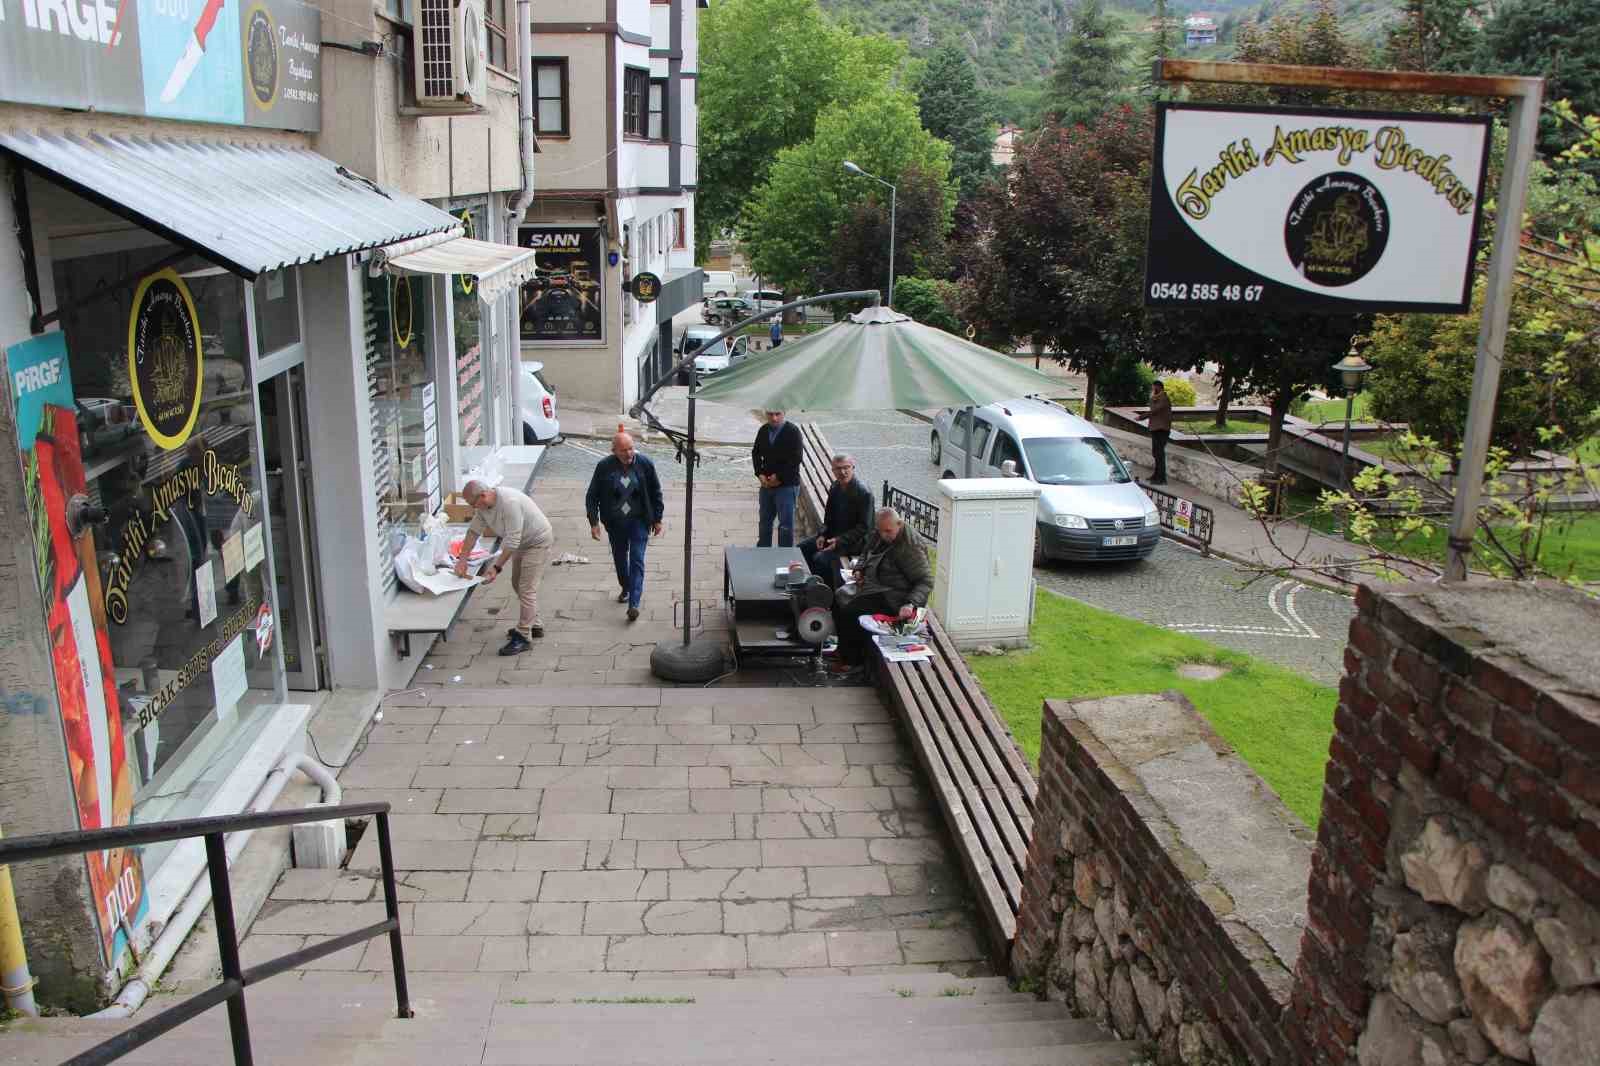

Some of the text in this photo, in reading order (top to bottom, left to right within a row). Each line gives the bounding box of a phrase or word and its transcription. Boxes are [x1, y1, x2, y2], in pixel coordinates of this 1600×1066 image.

[1176, 137, 1261, 221] Tarihi
[1264, 125, 1369, 167] Amasya
[530, 233, 581, 247] SANN
[1150, 282, 1264, 302] 0542 585 48 67
[106, 510, 148, 625] Tarihi
[152, 465, 200, 532] Amasya
